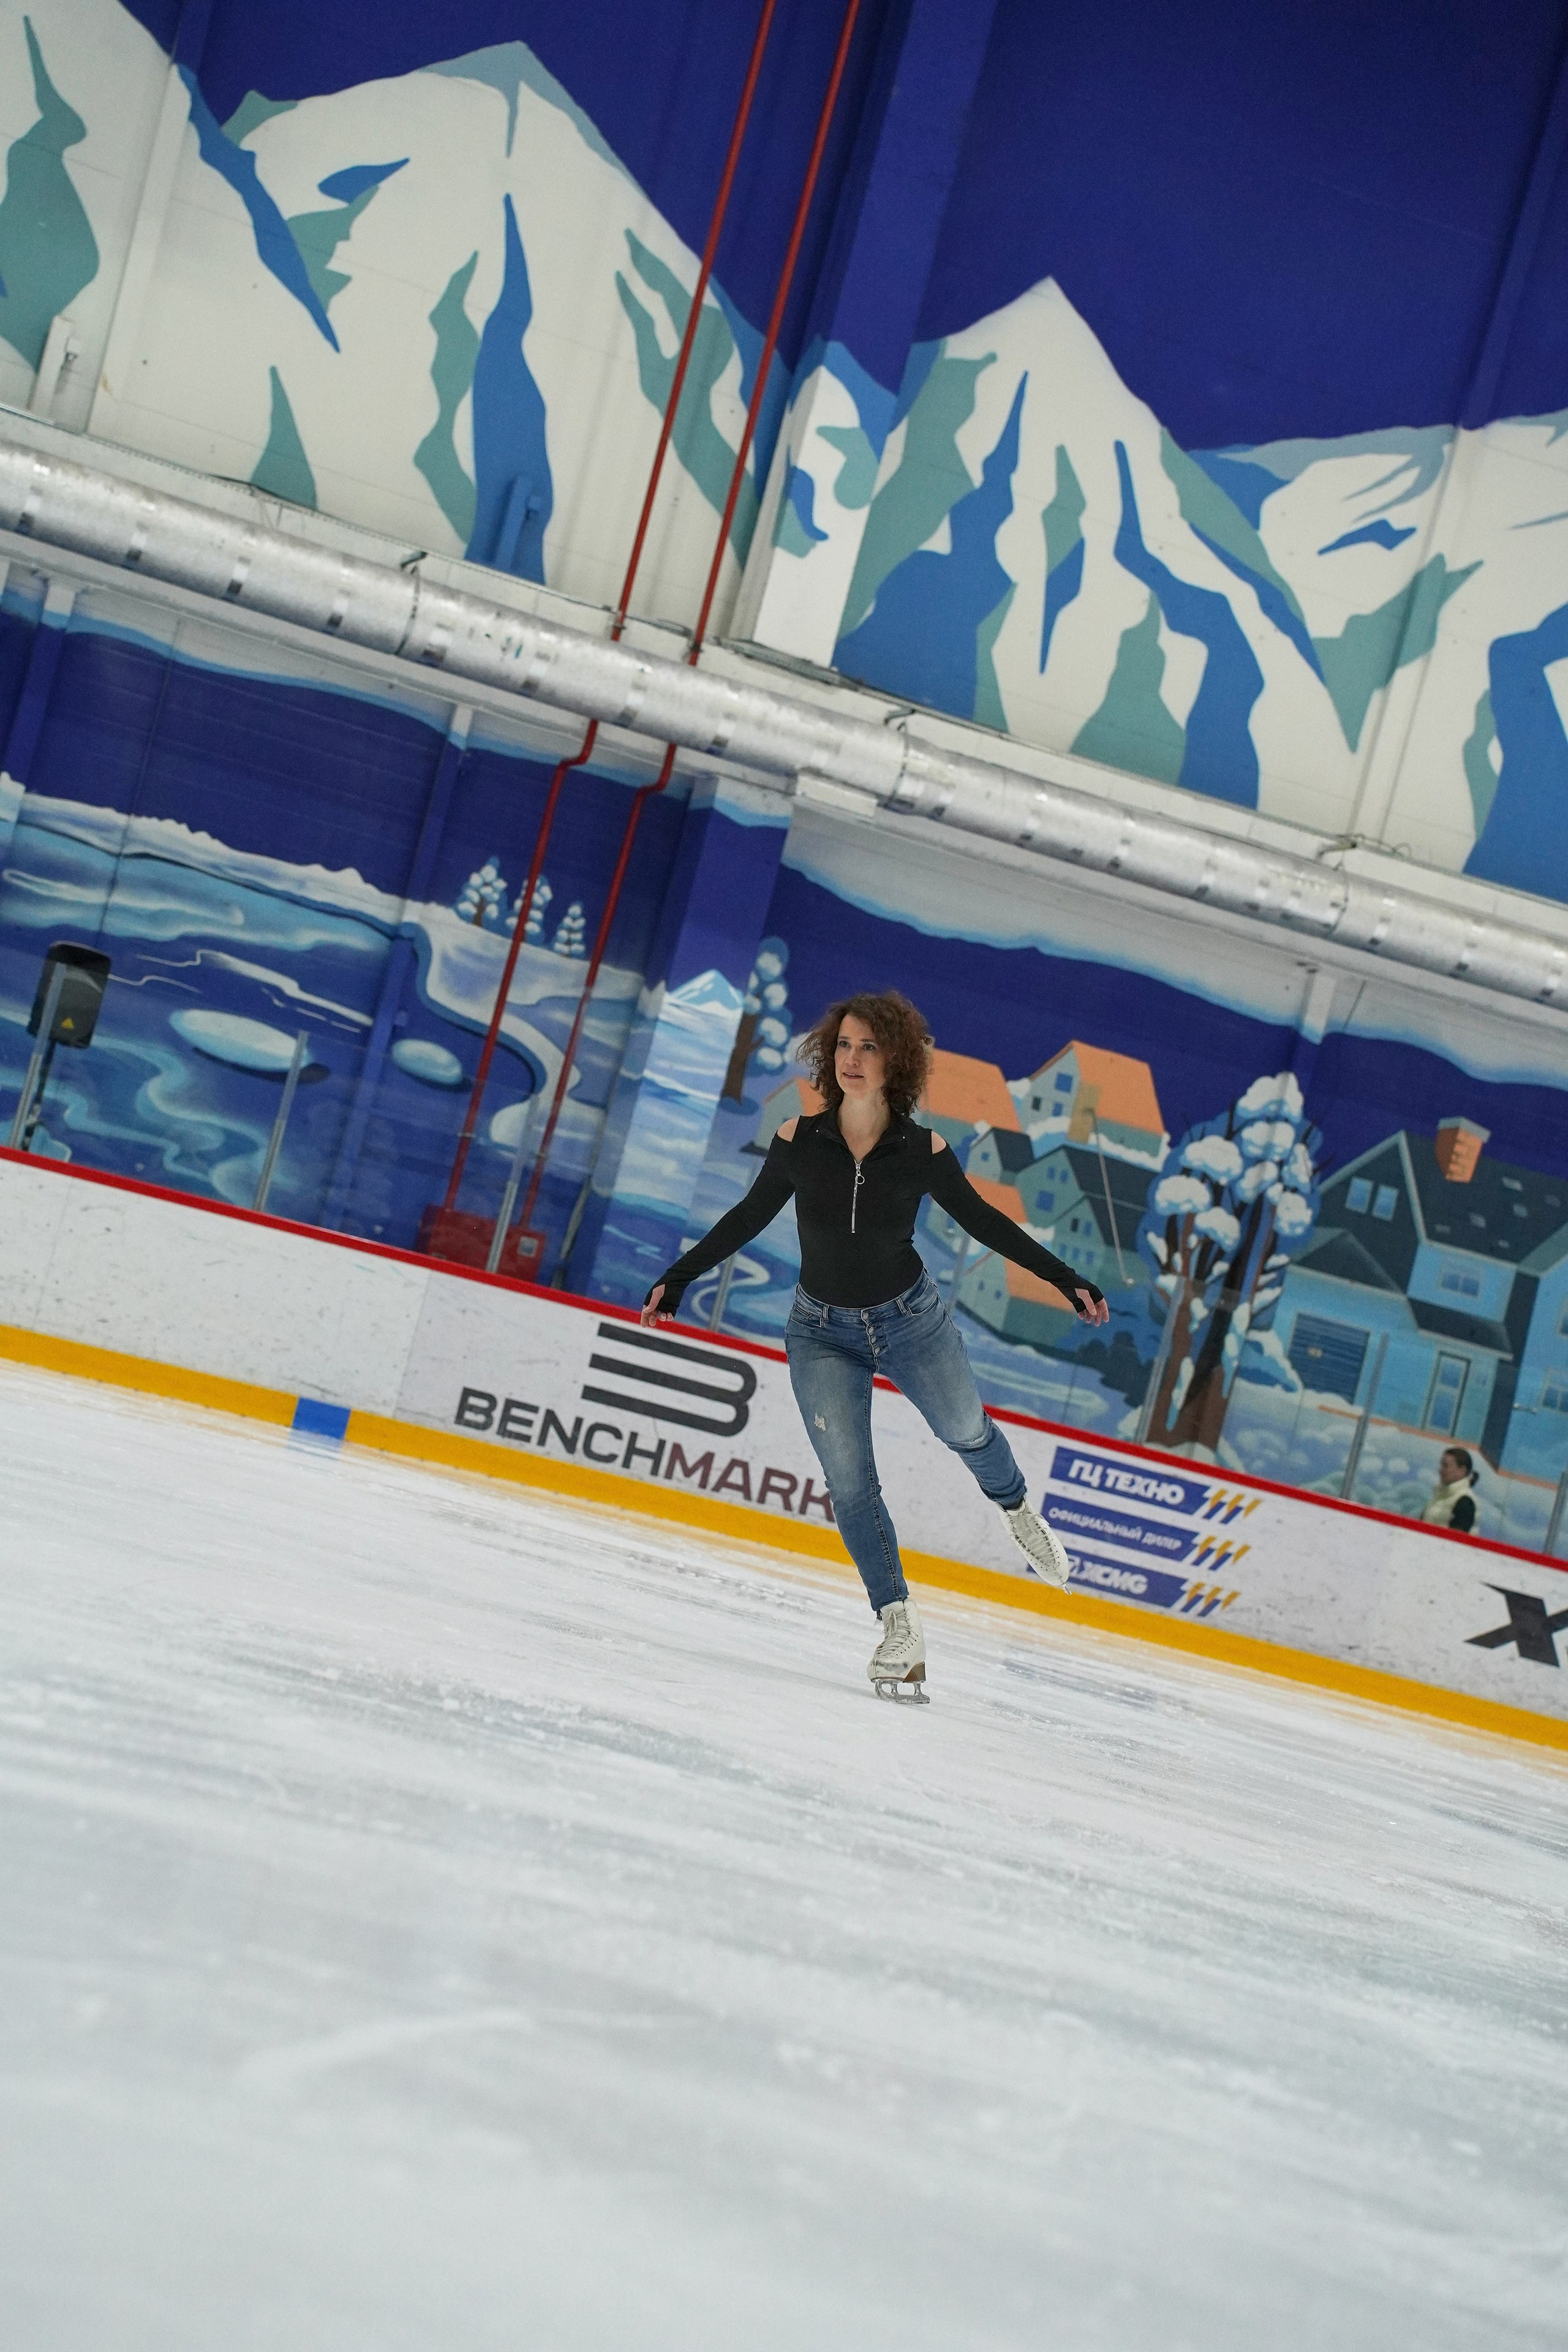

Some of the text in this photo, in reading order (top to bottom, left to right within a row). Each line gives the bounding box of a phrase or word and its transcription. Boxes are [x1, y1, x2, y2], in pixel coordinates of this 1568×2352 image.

[454, 1387, 835, 1523] BENCHMARK
[1068, 1458, 1185, 1506] ГЦ ТЕХНО
[1077, 1561, 1148, 1594] XCMG
